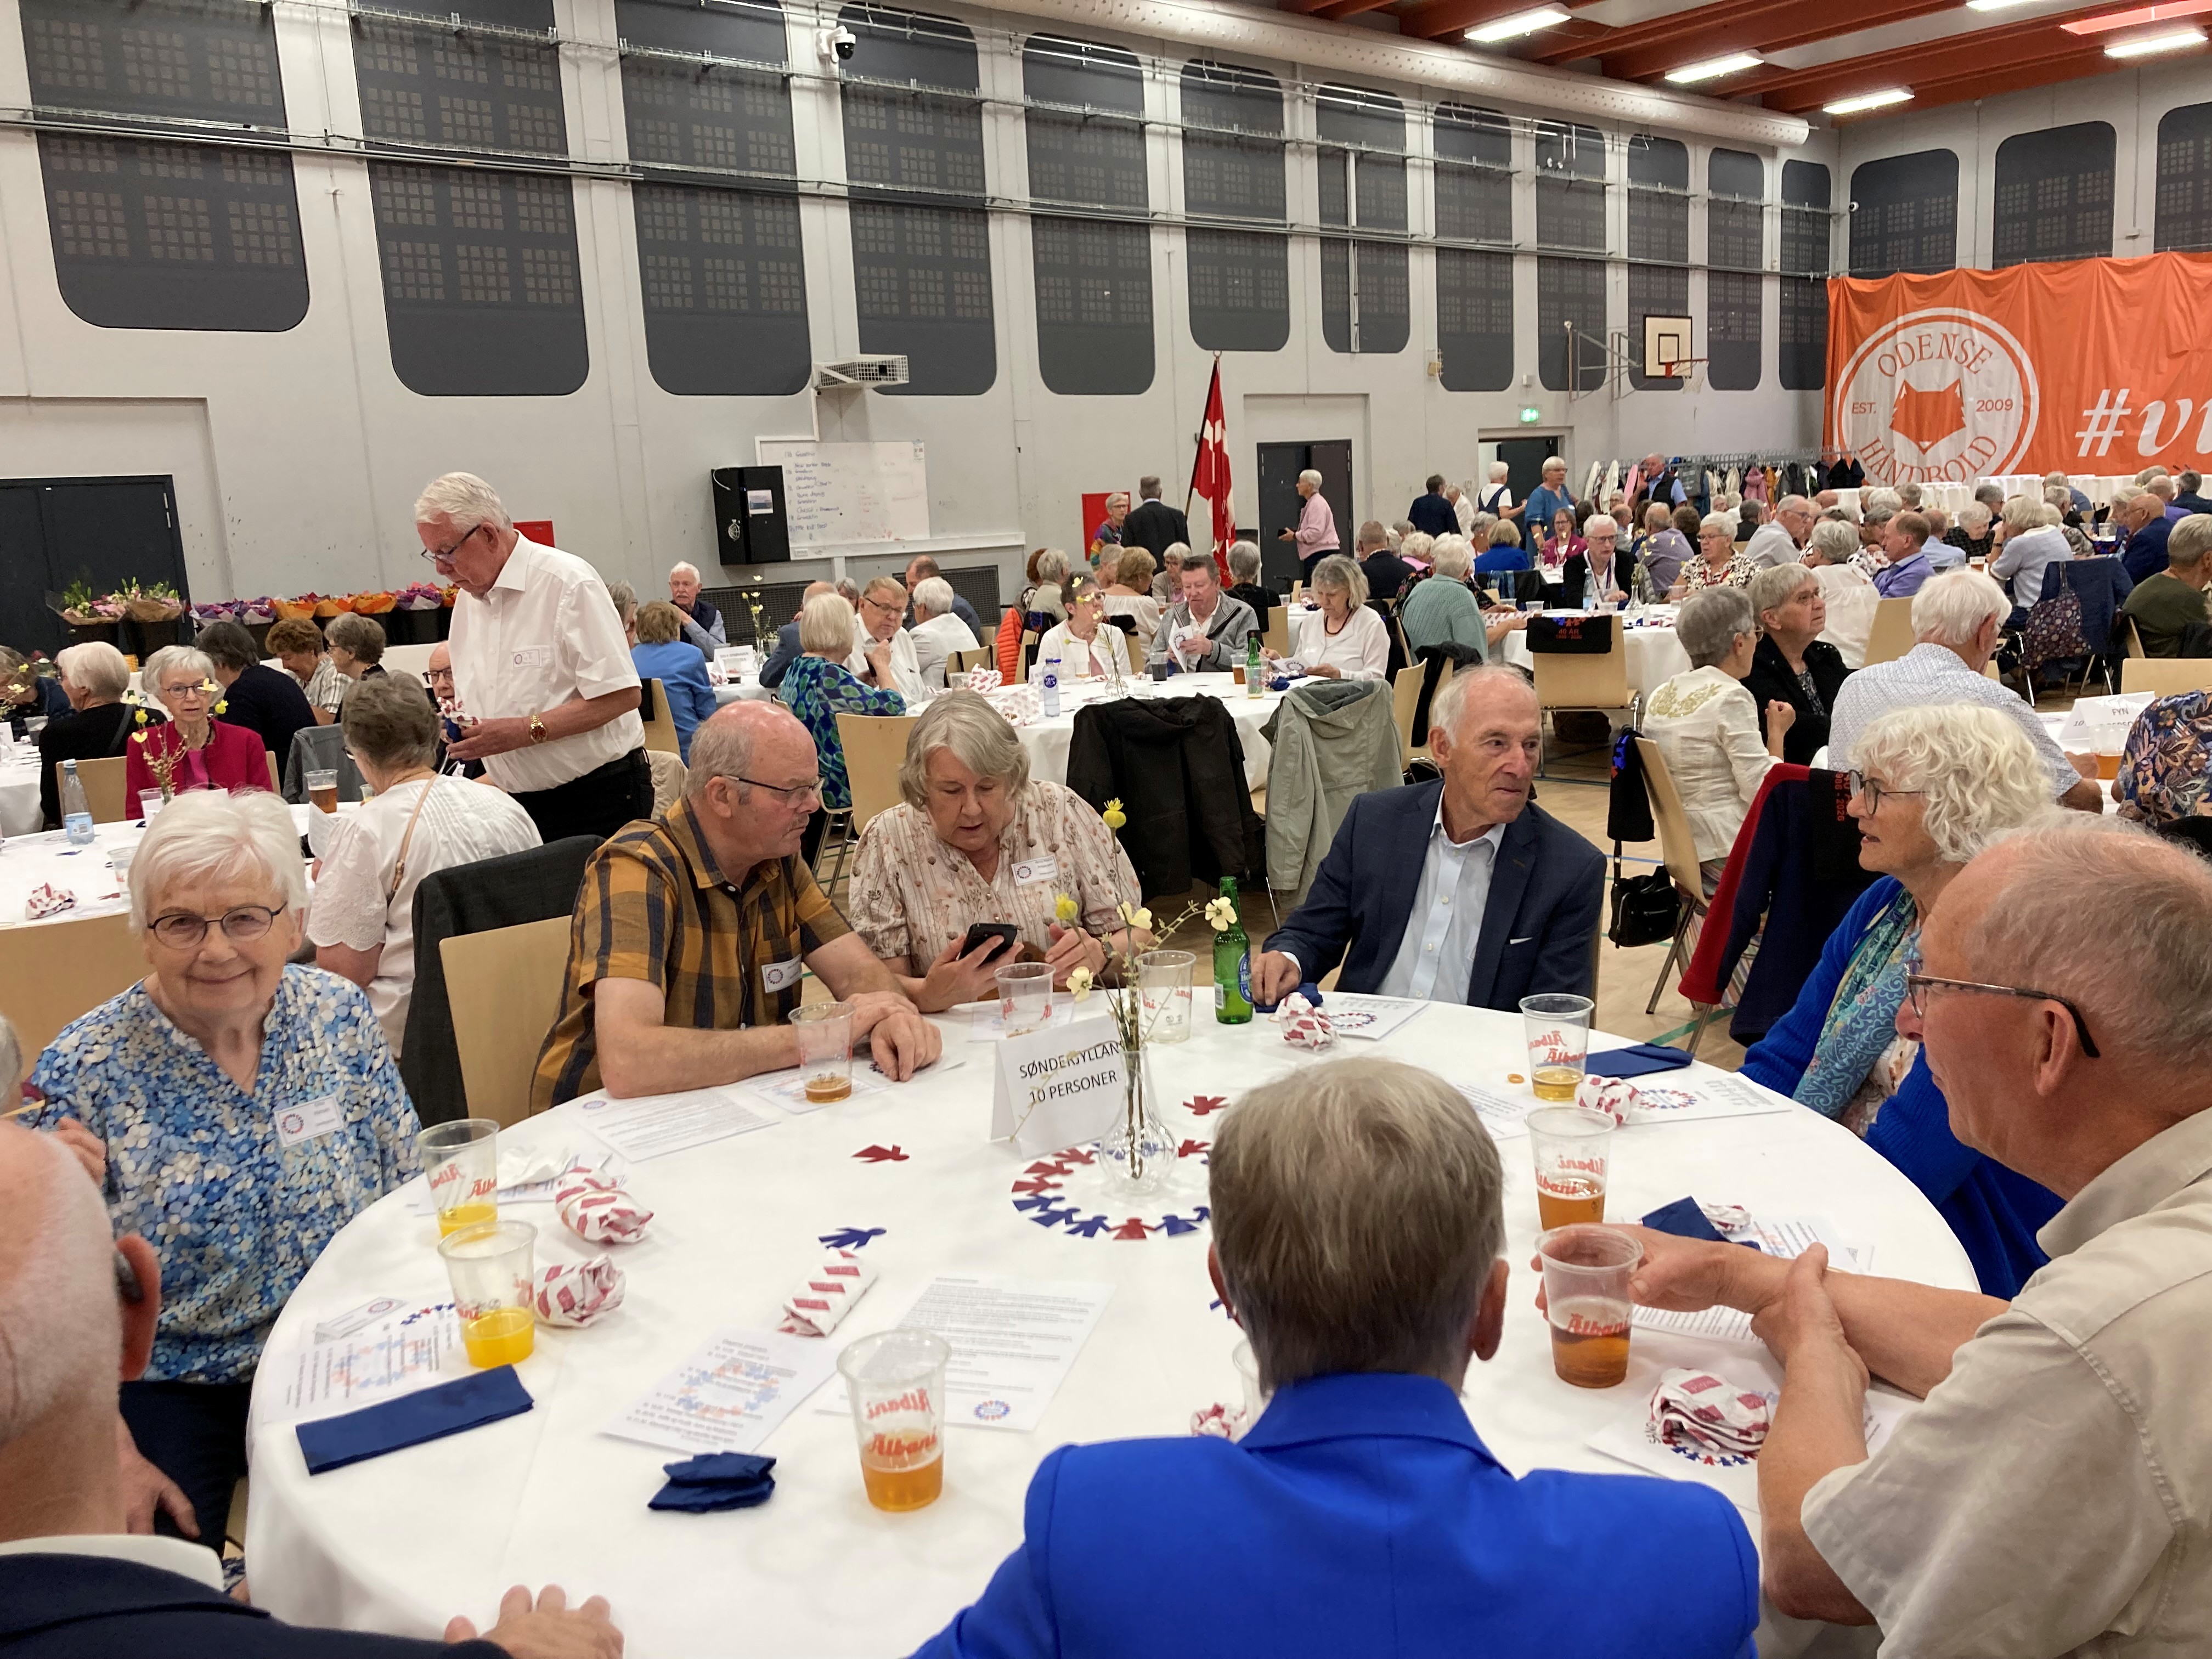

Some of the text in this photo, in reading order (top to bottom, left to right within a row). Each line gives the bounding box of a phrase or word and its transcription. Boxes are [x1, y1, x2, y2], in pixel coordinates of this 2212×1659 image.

[1878, 332, 1993, 377] ODENSE
[1852, 402, 1877, 414] EST.
[1976, 399, 2013, 412] 2009
[1019, 1043, 1120, 1079] SØNDEYLLAN
[1029, 1070, 1118, 1103] 10 PERSONER
[1567, 1312, 1629, 1336] Albani
[869, 1425, 938, 1457] Albani
